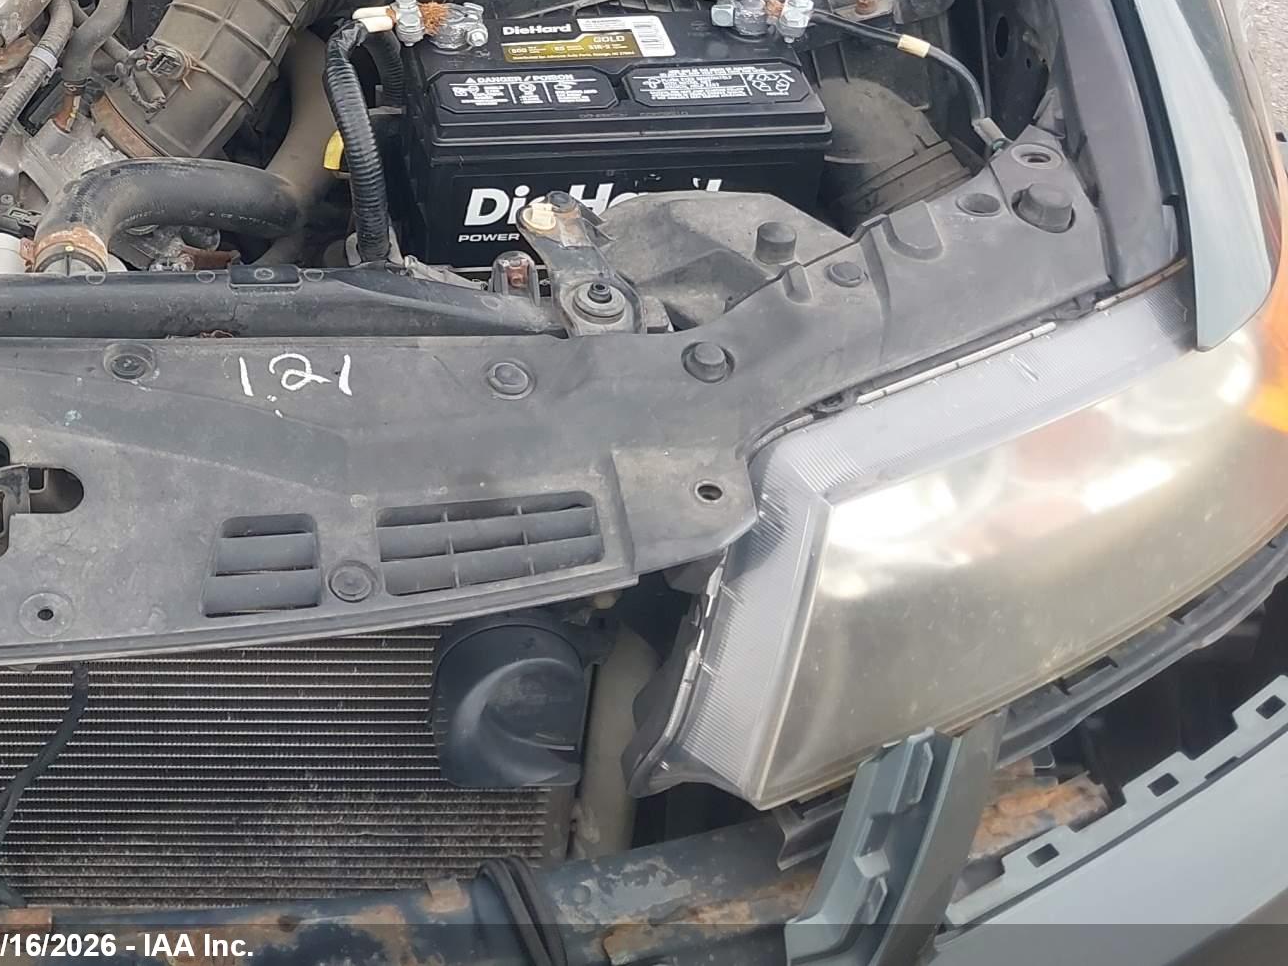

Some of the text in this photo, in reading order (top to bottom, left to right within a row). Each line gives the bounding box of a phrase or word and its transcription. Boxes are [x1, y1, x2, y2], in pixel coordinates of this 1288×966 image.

[502, 23, 572, 36] DieHard
[593, 35, 625, 43] GOLD
[477, 75, 522, 84] DANGER
[532, 73, 574, 82] POISON
[458, 233, 520, 243] POWER
